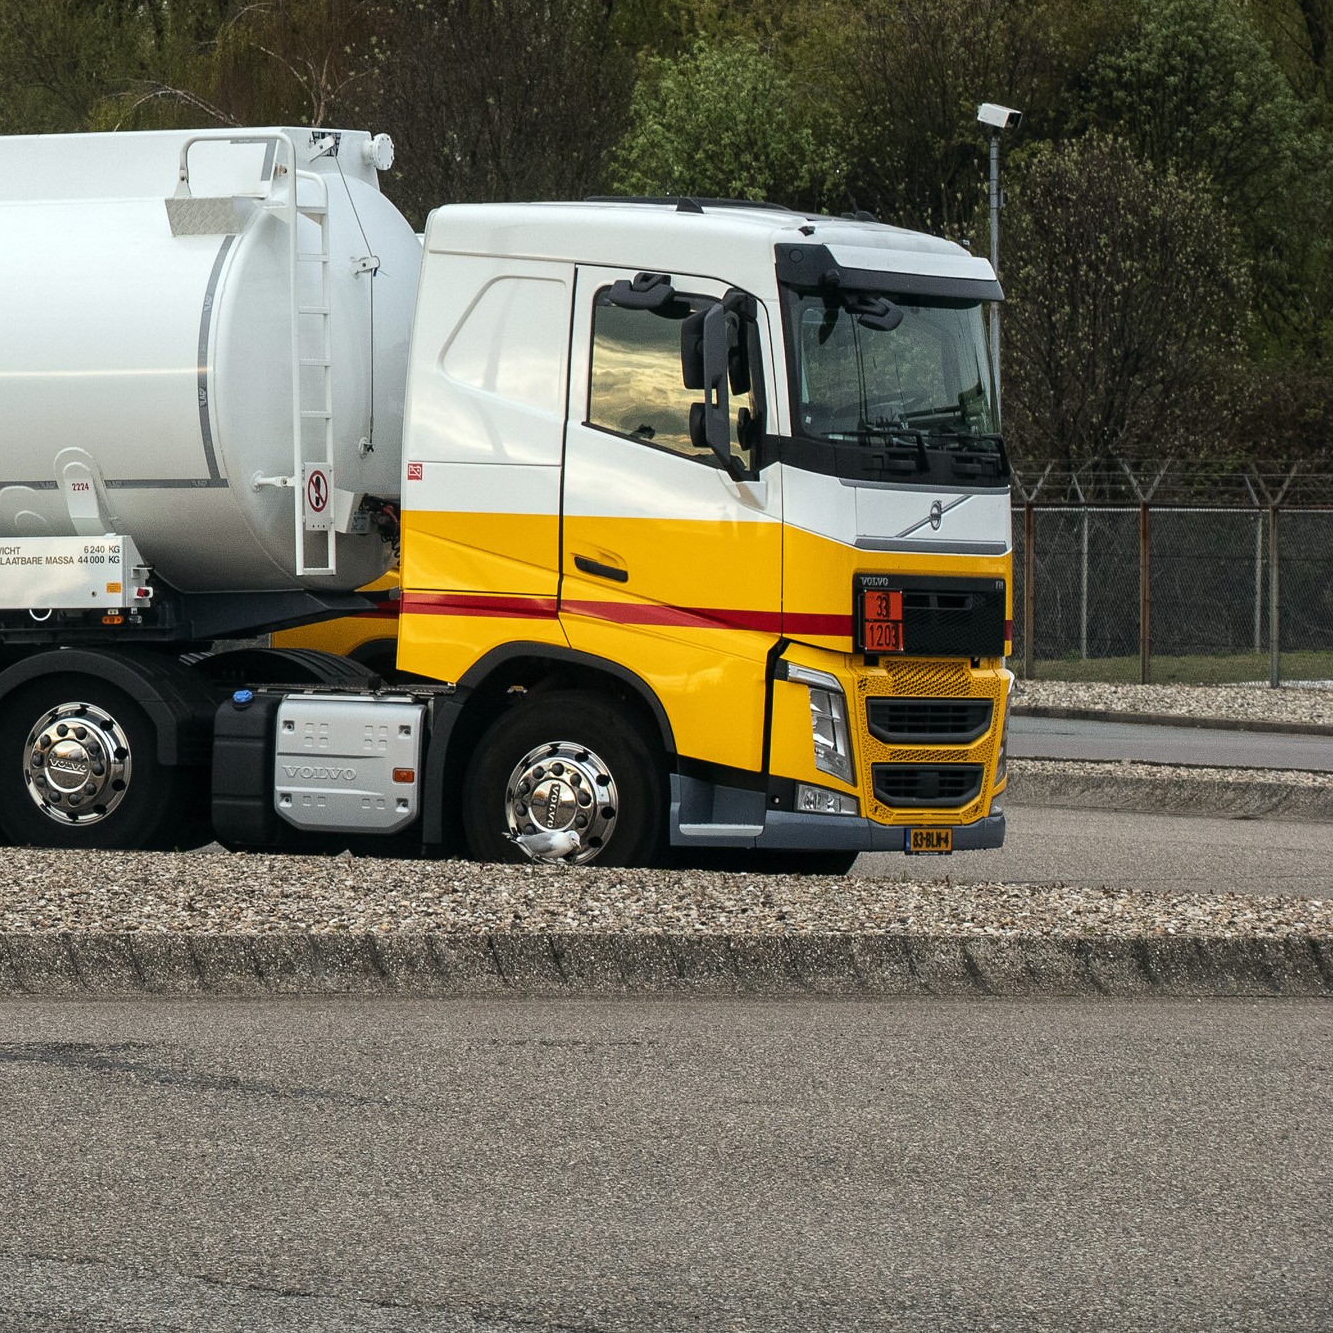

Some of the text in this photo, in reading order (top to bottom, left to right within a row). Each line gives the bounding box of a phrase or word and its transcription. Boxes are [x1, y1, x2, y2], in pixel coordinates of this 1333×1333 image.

[71, 483, 90, 492] 2224
[108, 545, 120, 554] KG
[45, 556, 74, 565] MASSA
[108, 555, 120, 564] KG
[861, 577, 889, 586] VOLVO
[870, 624, 899, 648] 1203
[49, 757, 88, 772] VOLVO
[282, 767, 357, 781] VOLVO
[547, 785, 559, 828] VOLVO
